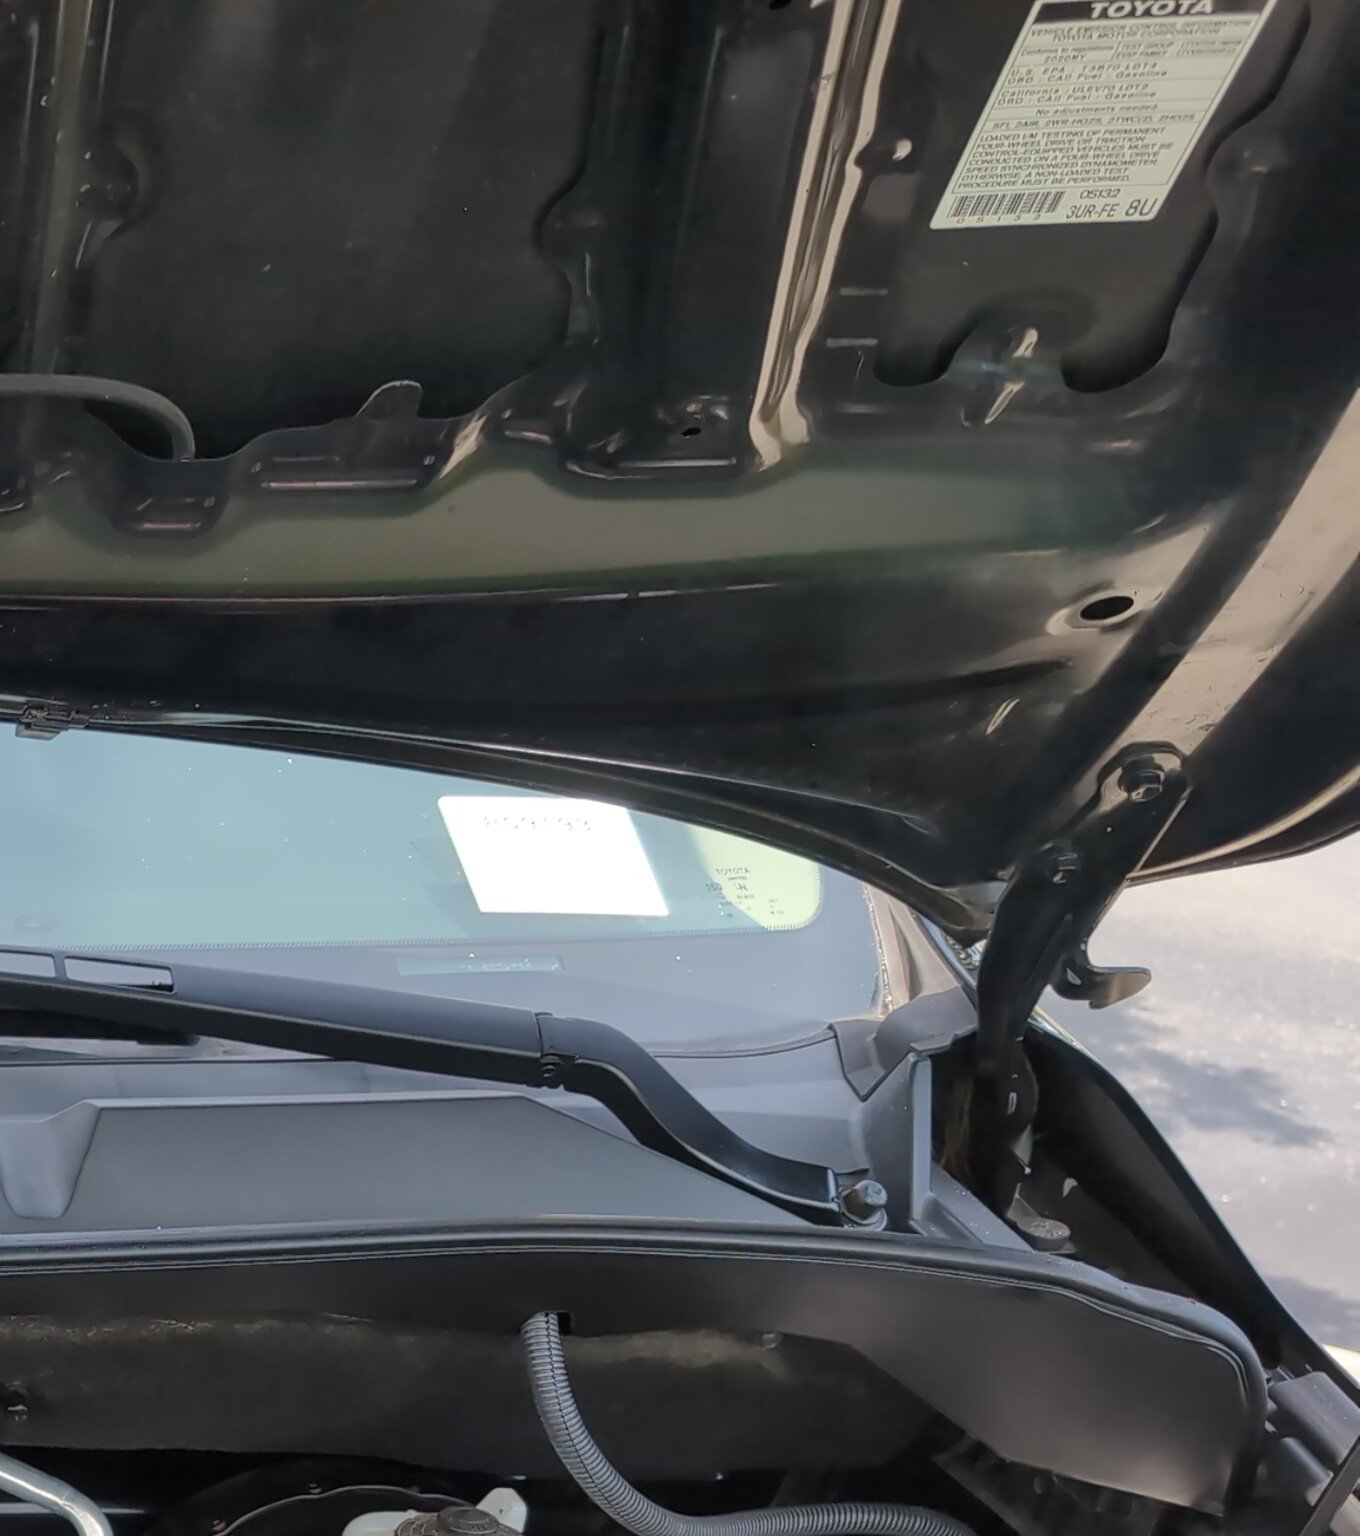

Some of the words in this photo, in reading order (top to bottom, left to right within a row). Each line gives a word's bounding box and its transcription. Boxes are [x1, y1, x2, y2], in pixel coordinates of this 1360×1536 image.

[1090, 0, 1214, 19] TOYOTA
[1065, 203, 1120, 219] 3UR-FE
[1125, 198, 1159, 217] 8U
